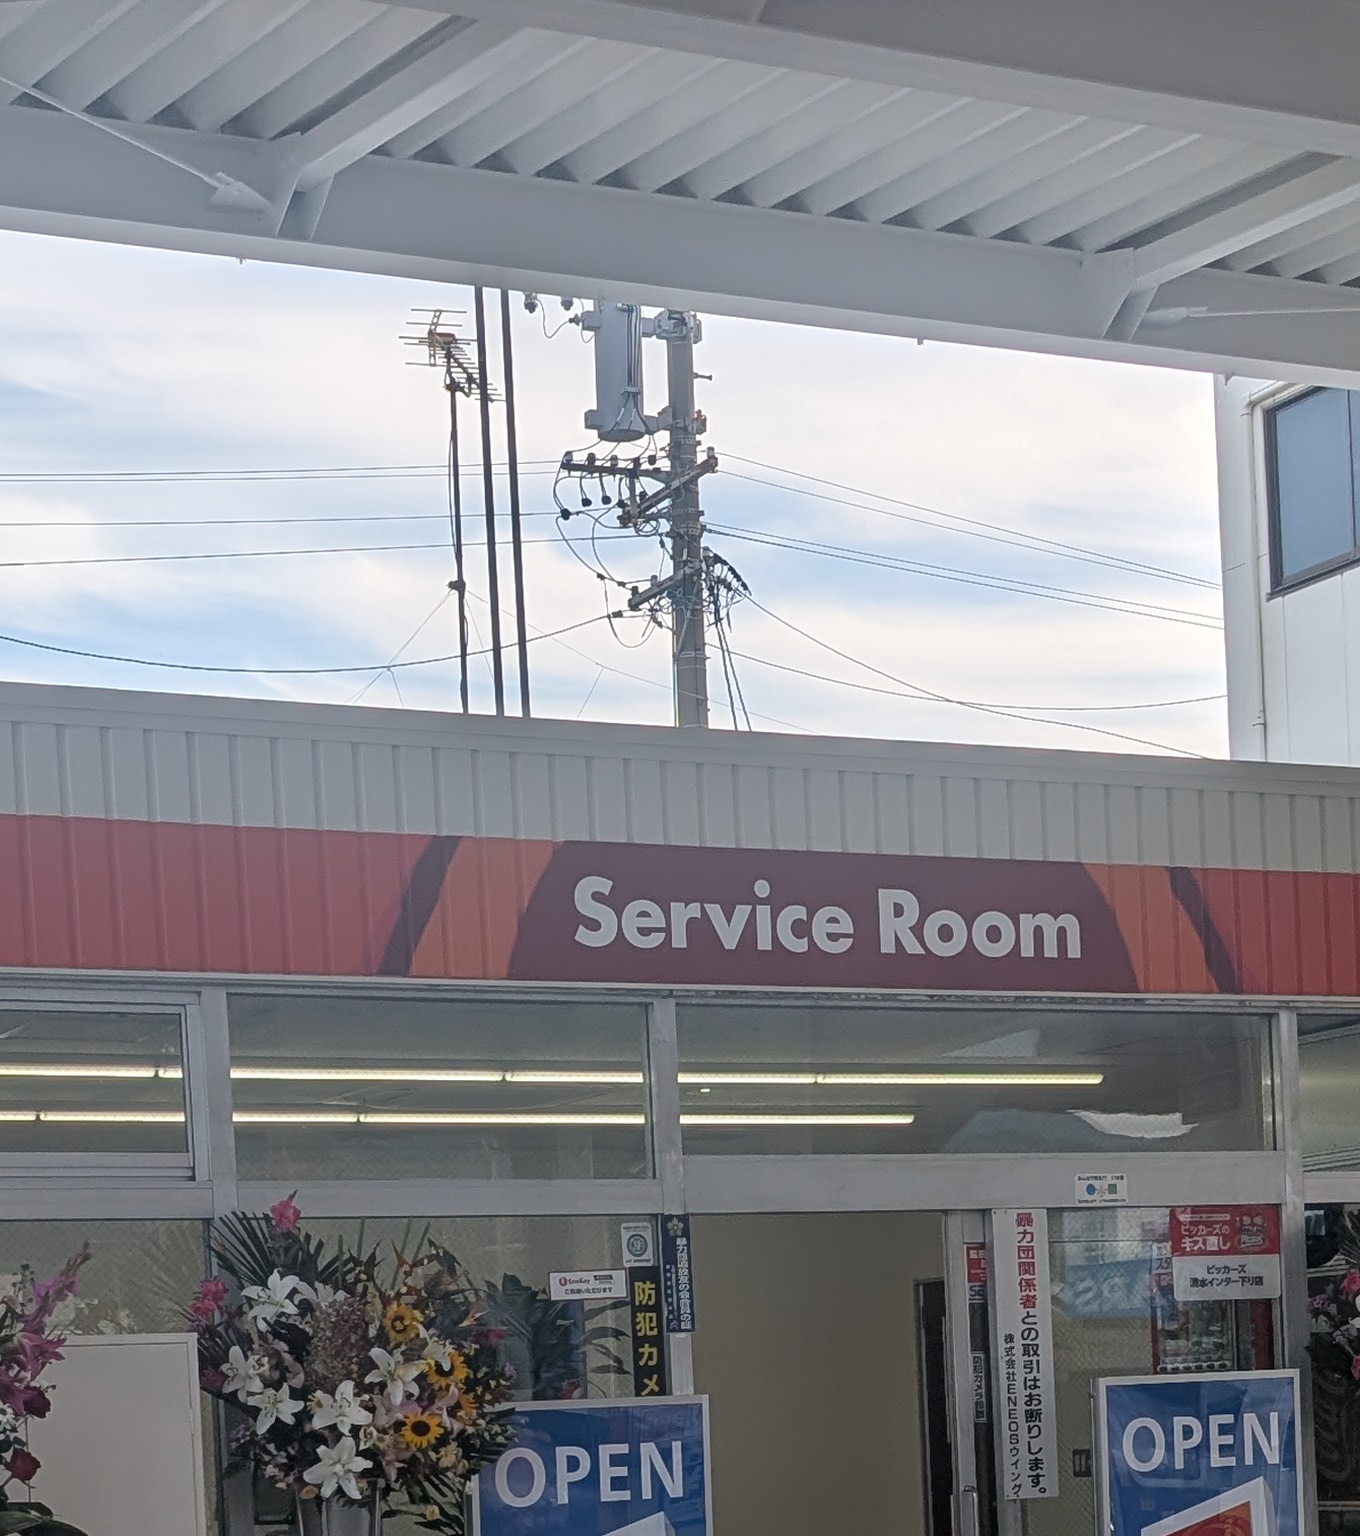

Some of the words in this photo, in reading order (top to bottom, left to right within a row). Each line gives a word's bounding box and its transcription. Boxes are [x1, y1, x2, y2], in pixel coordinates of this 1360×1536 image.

[574, 875, 854, 953] Service
[878, 888, 1082, 960] Room
[1015, 1212, 1047, 1494] 暴力団関係者との取引はお断りします。
[494, 1441, 684, 1508] OPEN
[1122, 1411, 1280, 1472] OPEN
